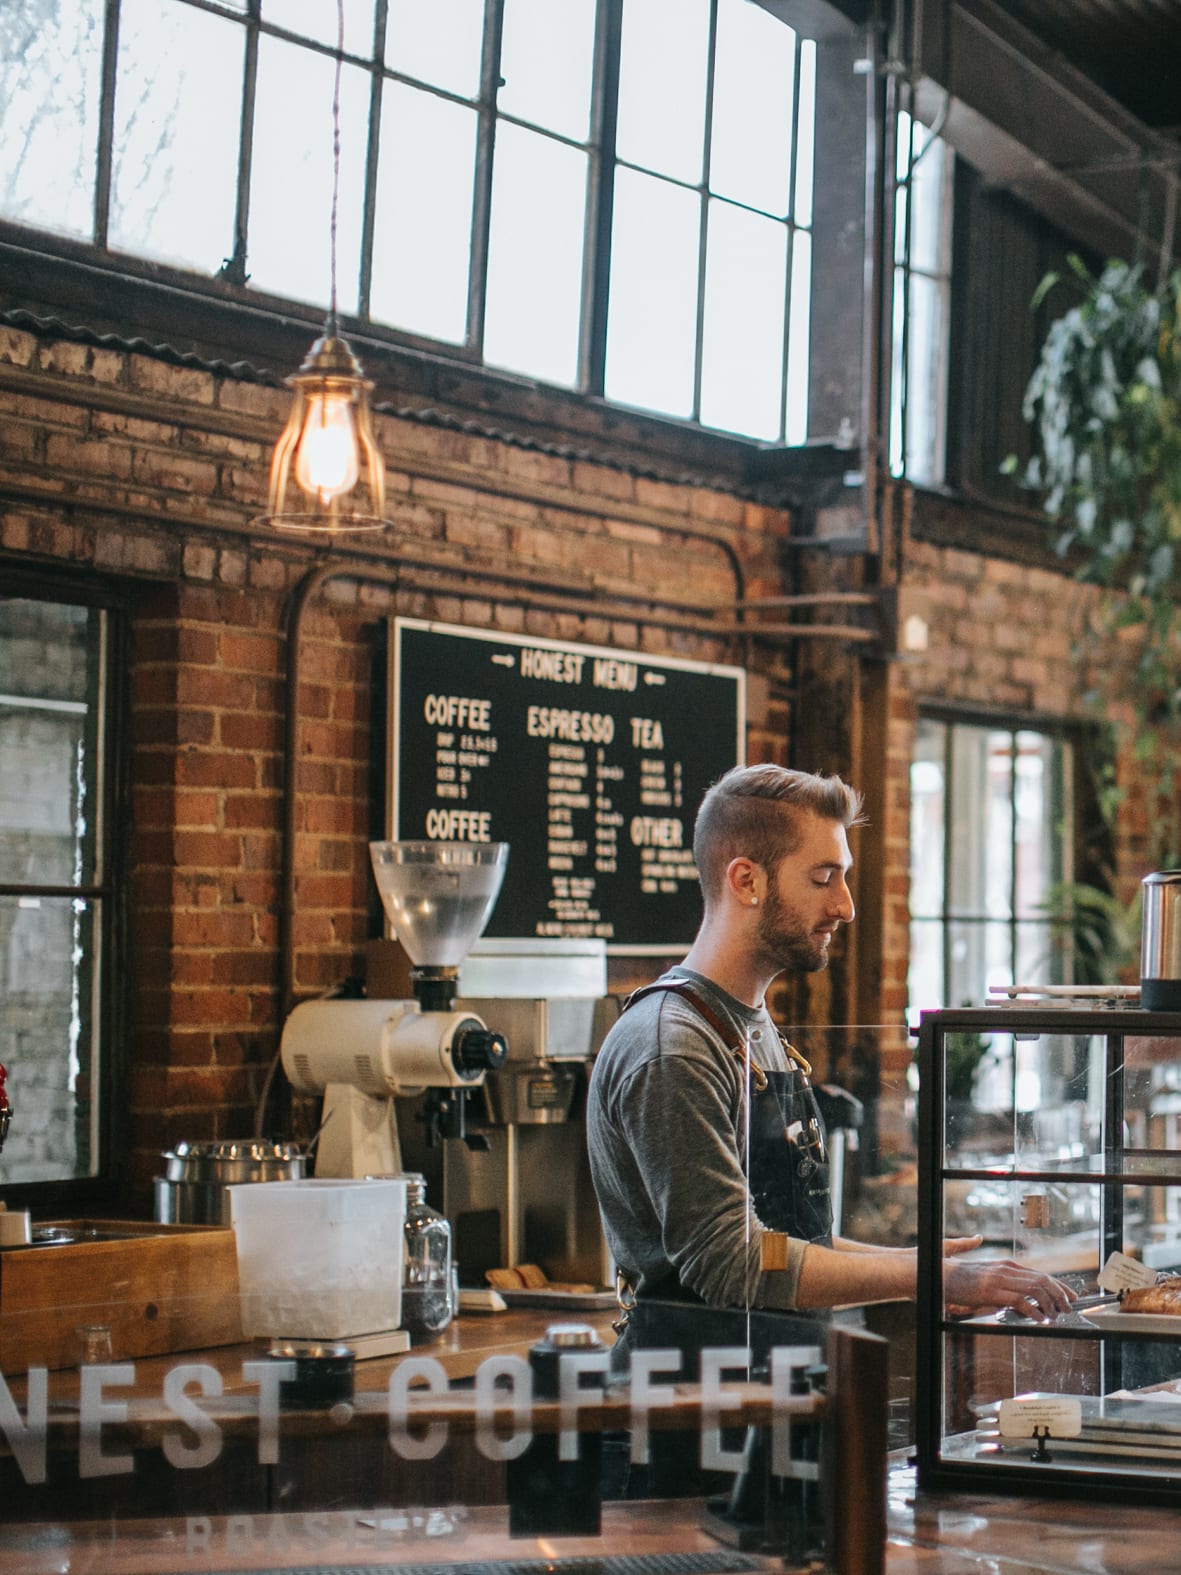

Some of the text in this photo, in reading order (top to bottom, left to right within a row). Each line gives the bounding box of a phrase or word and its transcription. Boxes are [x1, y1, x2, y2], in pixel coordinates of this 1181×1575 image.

[520, 648, 638, 692] HONEST MENU
[424, 694, 492, 731] COFFEE
[527, 705, 615, 744] ESPRESSO
[630, 717, 664, 750] TEA
[426, 808, 492, 843] COFFEE
[630, 816, 683, 848] OTHER
[0, 1345, 822, 1485] NEST COFFEE
